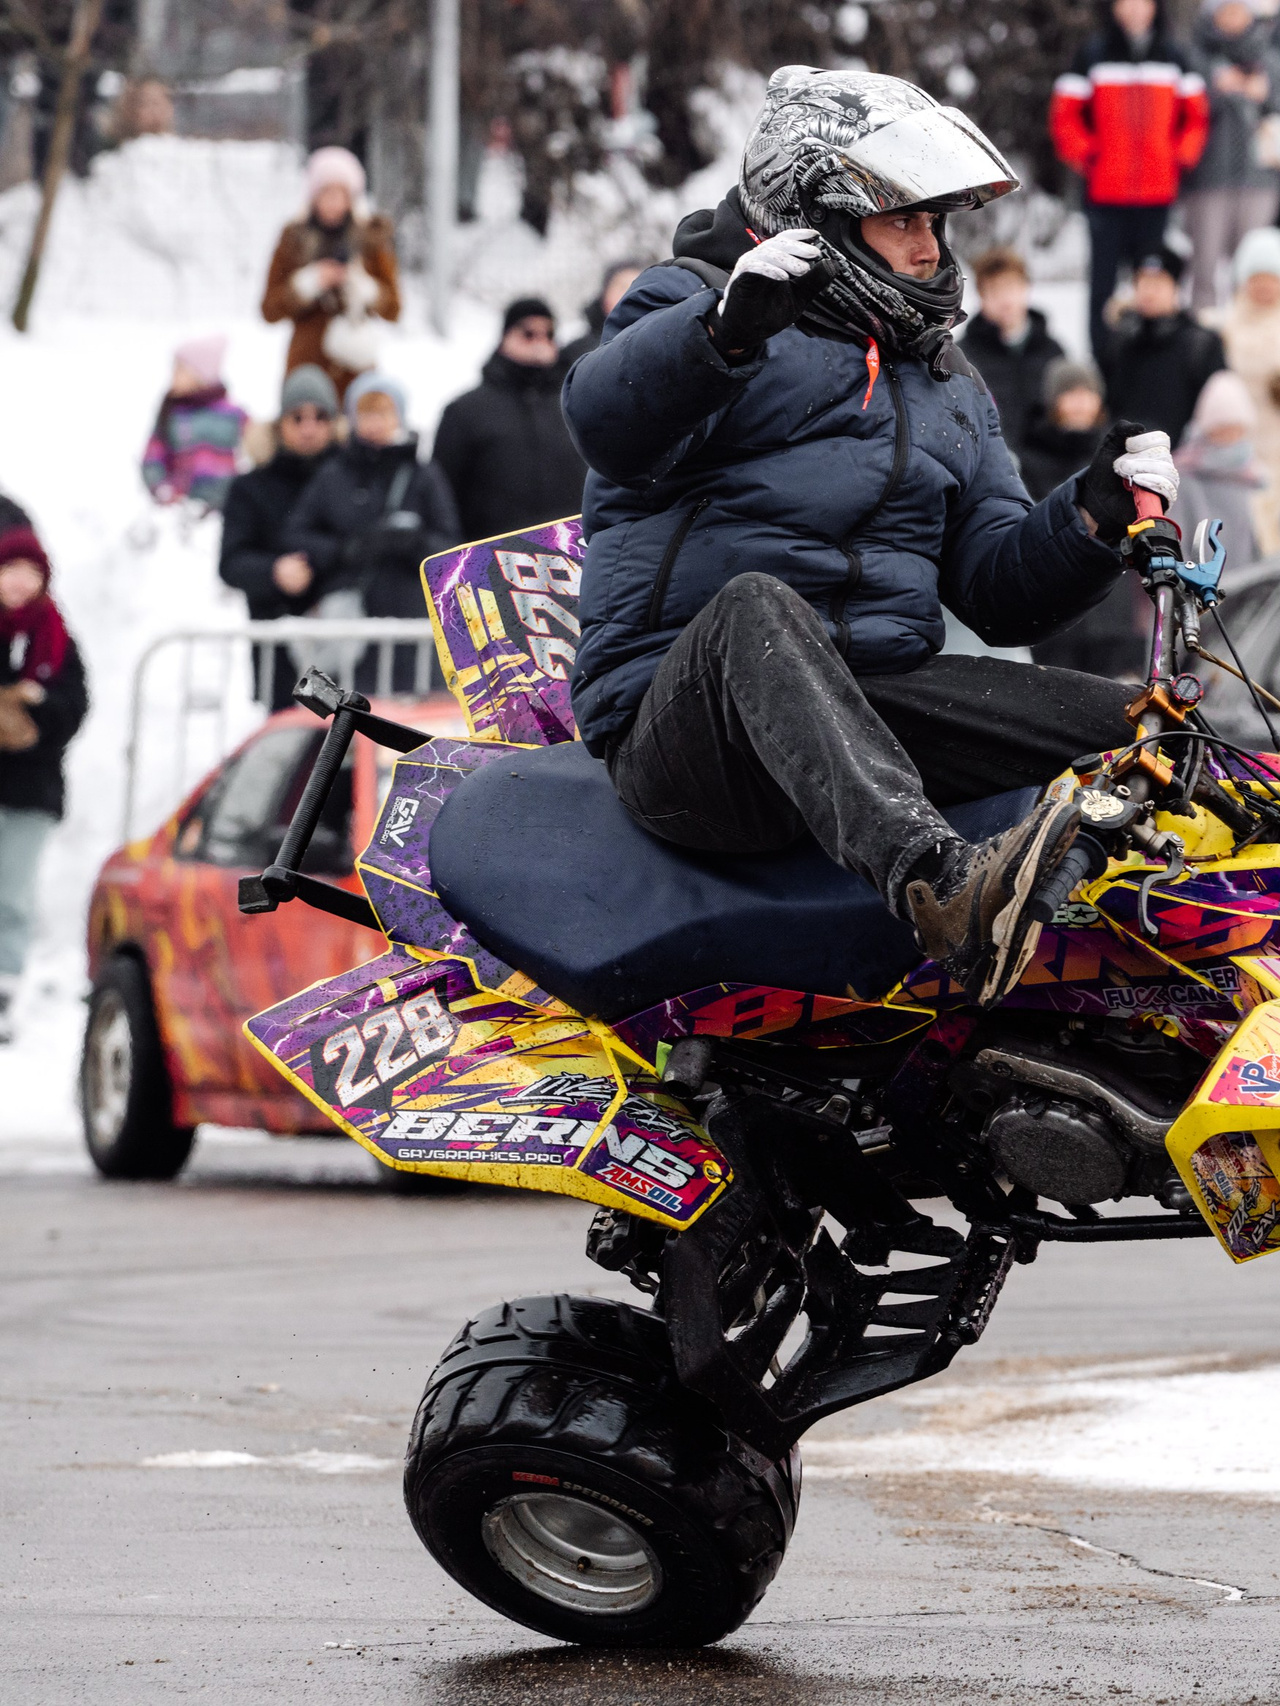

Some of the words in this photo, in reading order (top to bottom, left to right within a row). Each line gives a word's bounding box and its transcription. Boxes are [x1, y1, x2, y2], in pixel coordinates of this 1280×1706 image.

[494, 549, 582, 680] 228
[390, 797, 420, 848] GAV
[1103, 986, 1163, 1009] FUCK
[322, 988, 457, 1107] 228
[380, 1110, 696, 1189] BERNS
[398, 1148, 564, 1165] GAVGRAPHICS.PRO
[597, 1163, 682, 1211] AMSOIL
[1227, 1198, 1249, 1245] FOX
[1252, 1199, 1276, 1244] GAV
[512, 1471, 560, 1486] KENDA
[562, 1481, 655, 1527] SPEEDRACER
